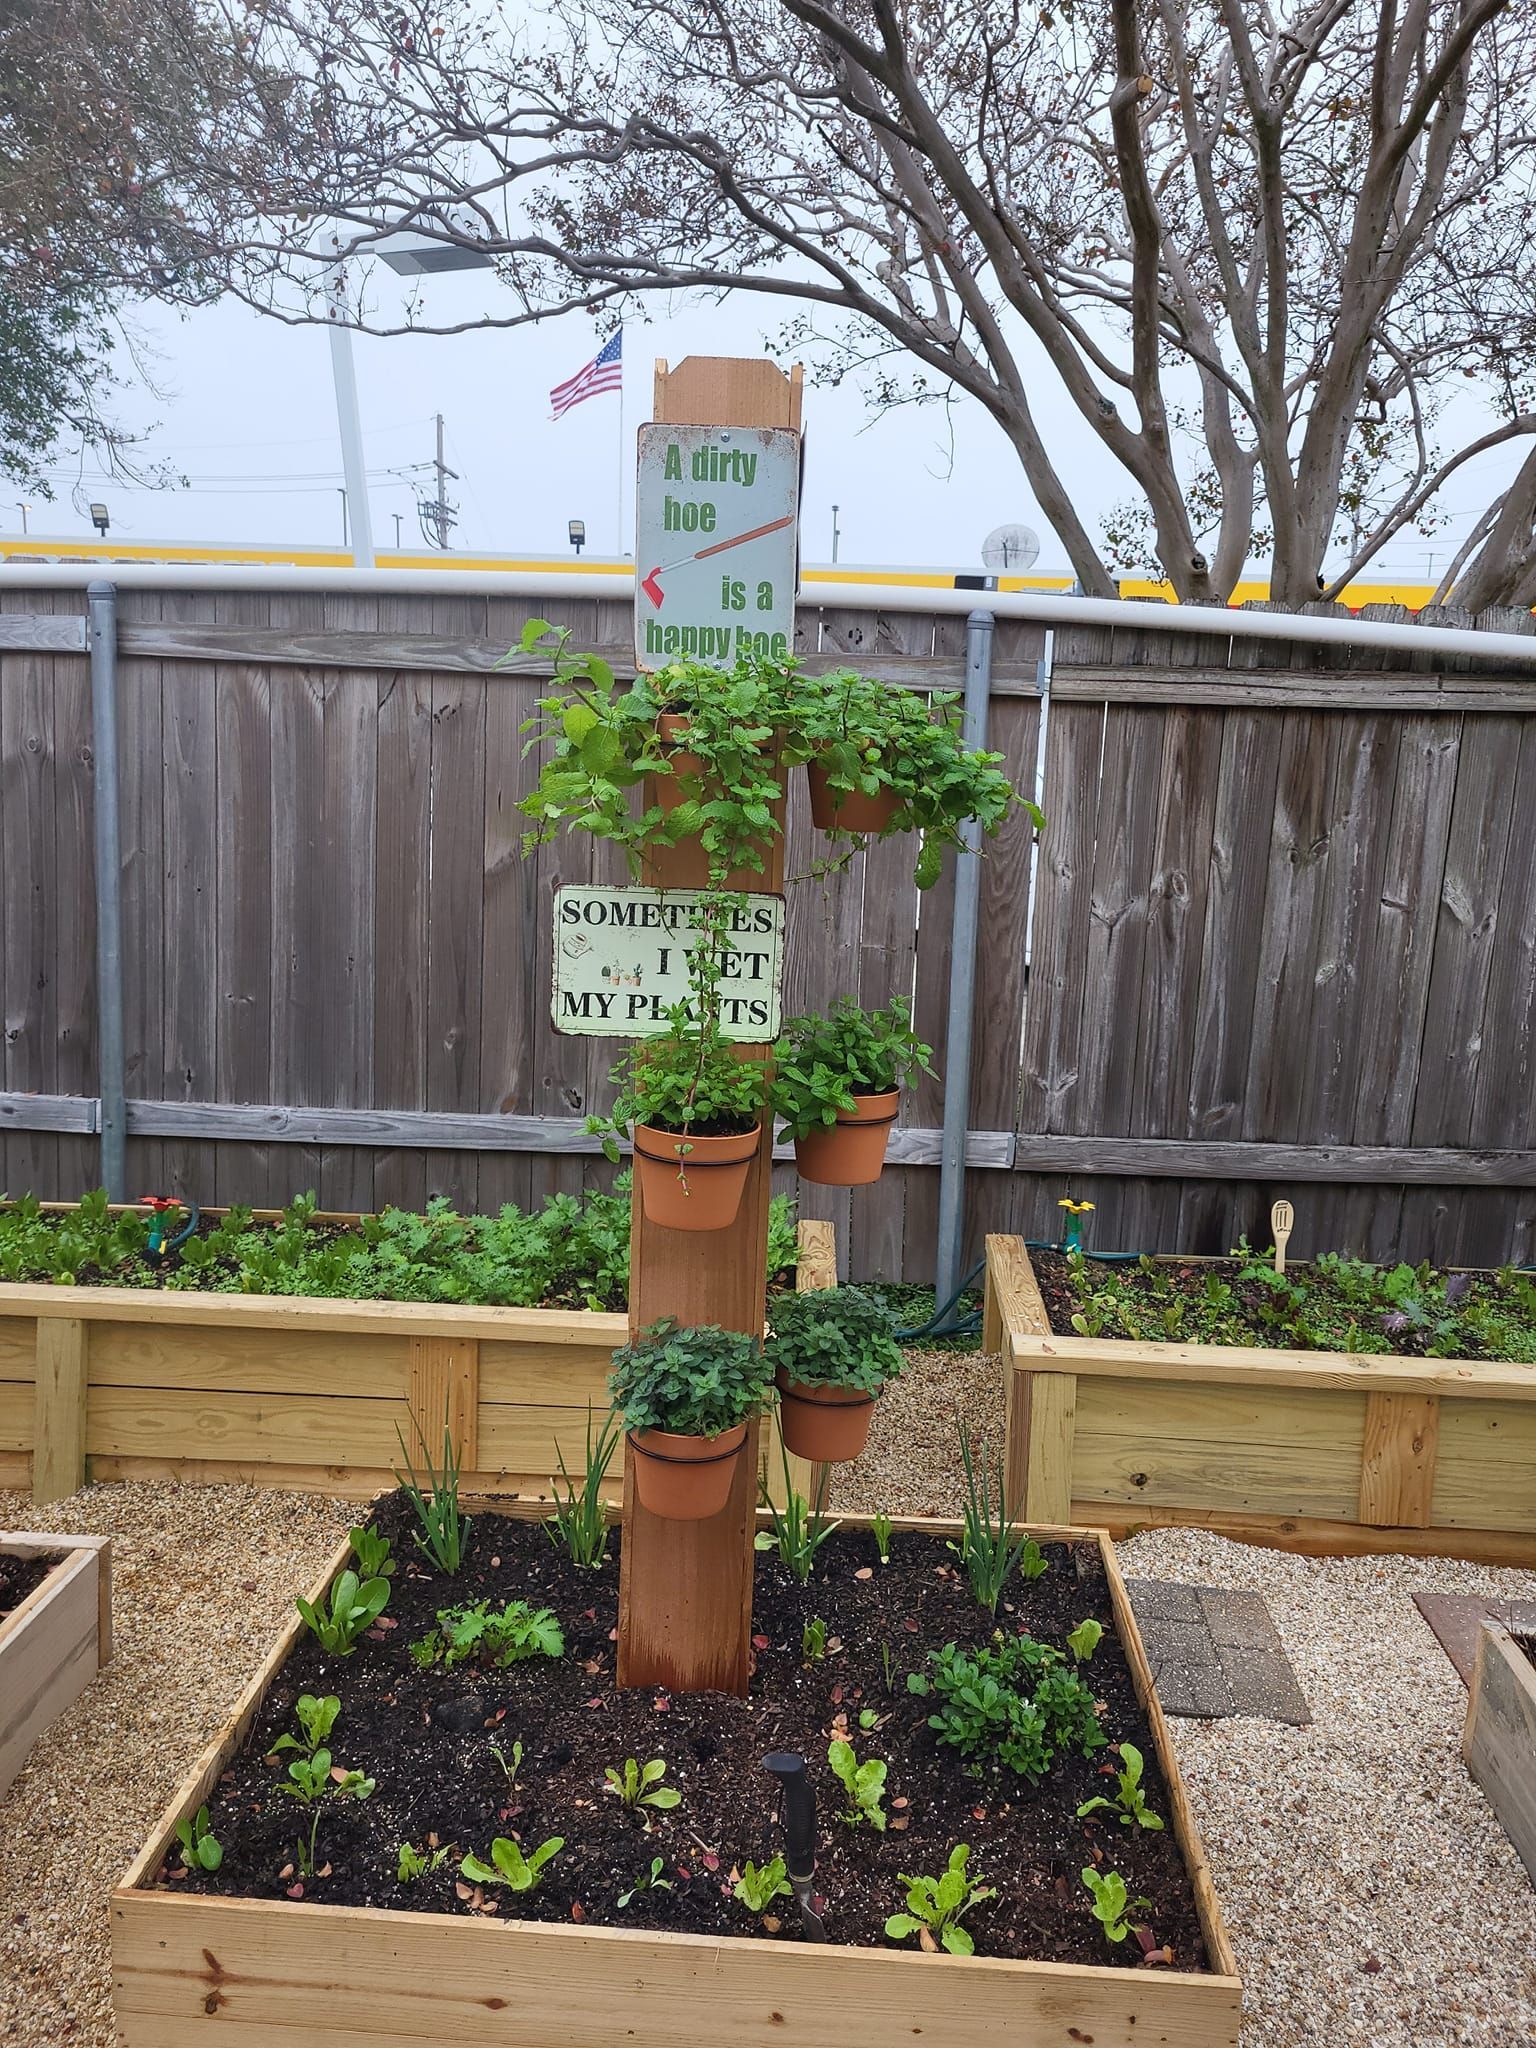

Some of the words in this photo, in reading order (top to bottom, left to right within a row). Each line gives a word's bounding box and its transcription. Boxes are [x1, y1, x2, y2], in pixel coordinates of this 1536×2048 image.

[664, 444, 683, 481] A
[691, 446, 757, 487] dirty
[664, 495, 716, 533] hoe
[721, 575, 746, 611] is
[757, 581, 773, 611] a
[646, 618, 731, 660] happy
[656, 947, 672, 975] I
[562, 991, 617, 1018] MY
[625, 993, 769, 1026] PLATS
